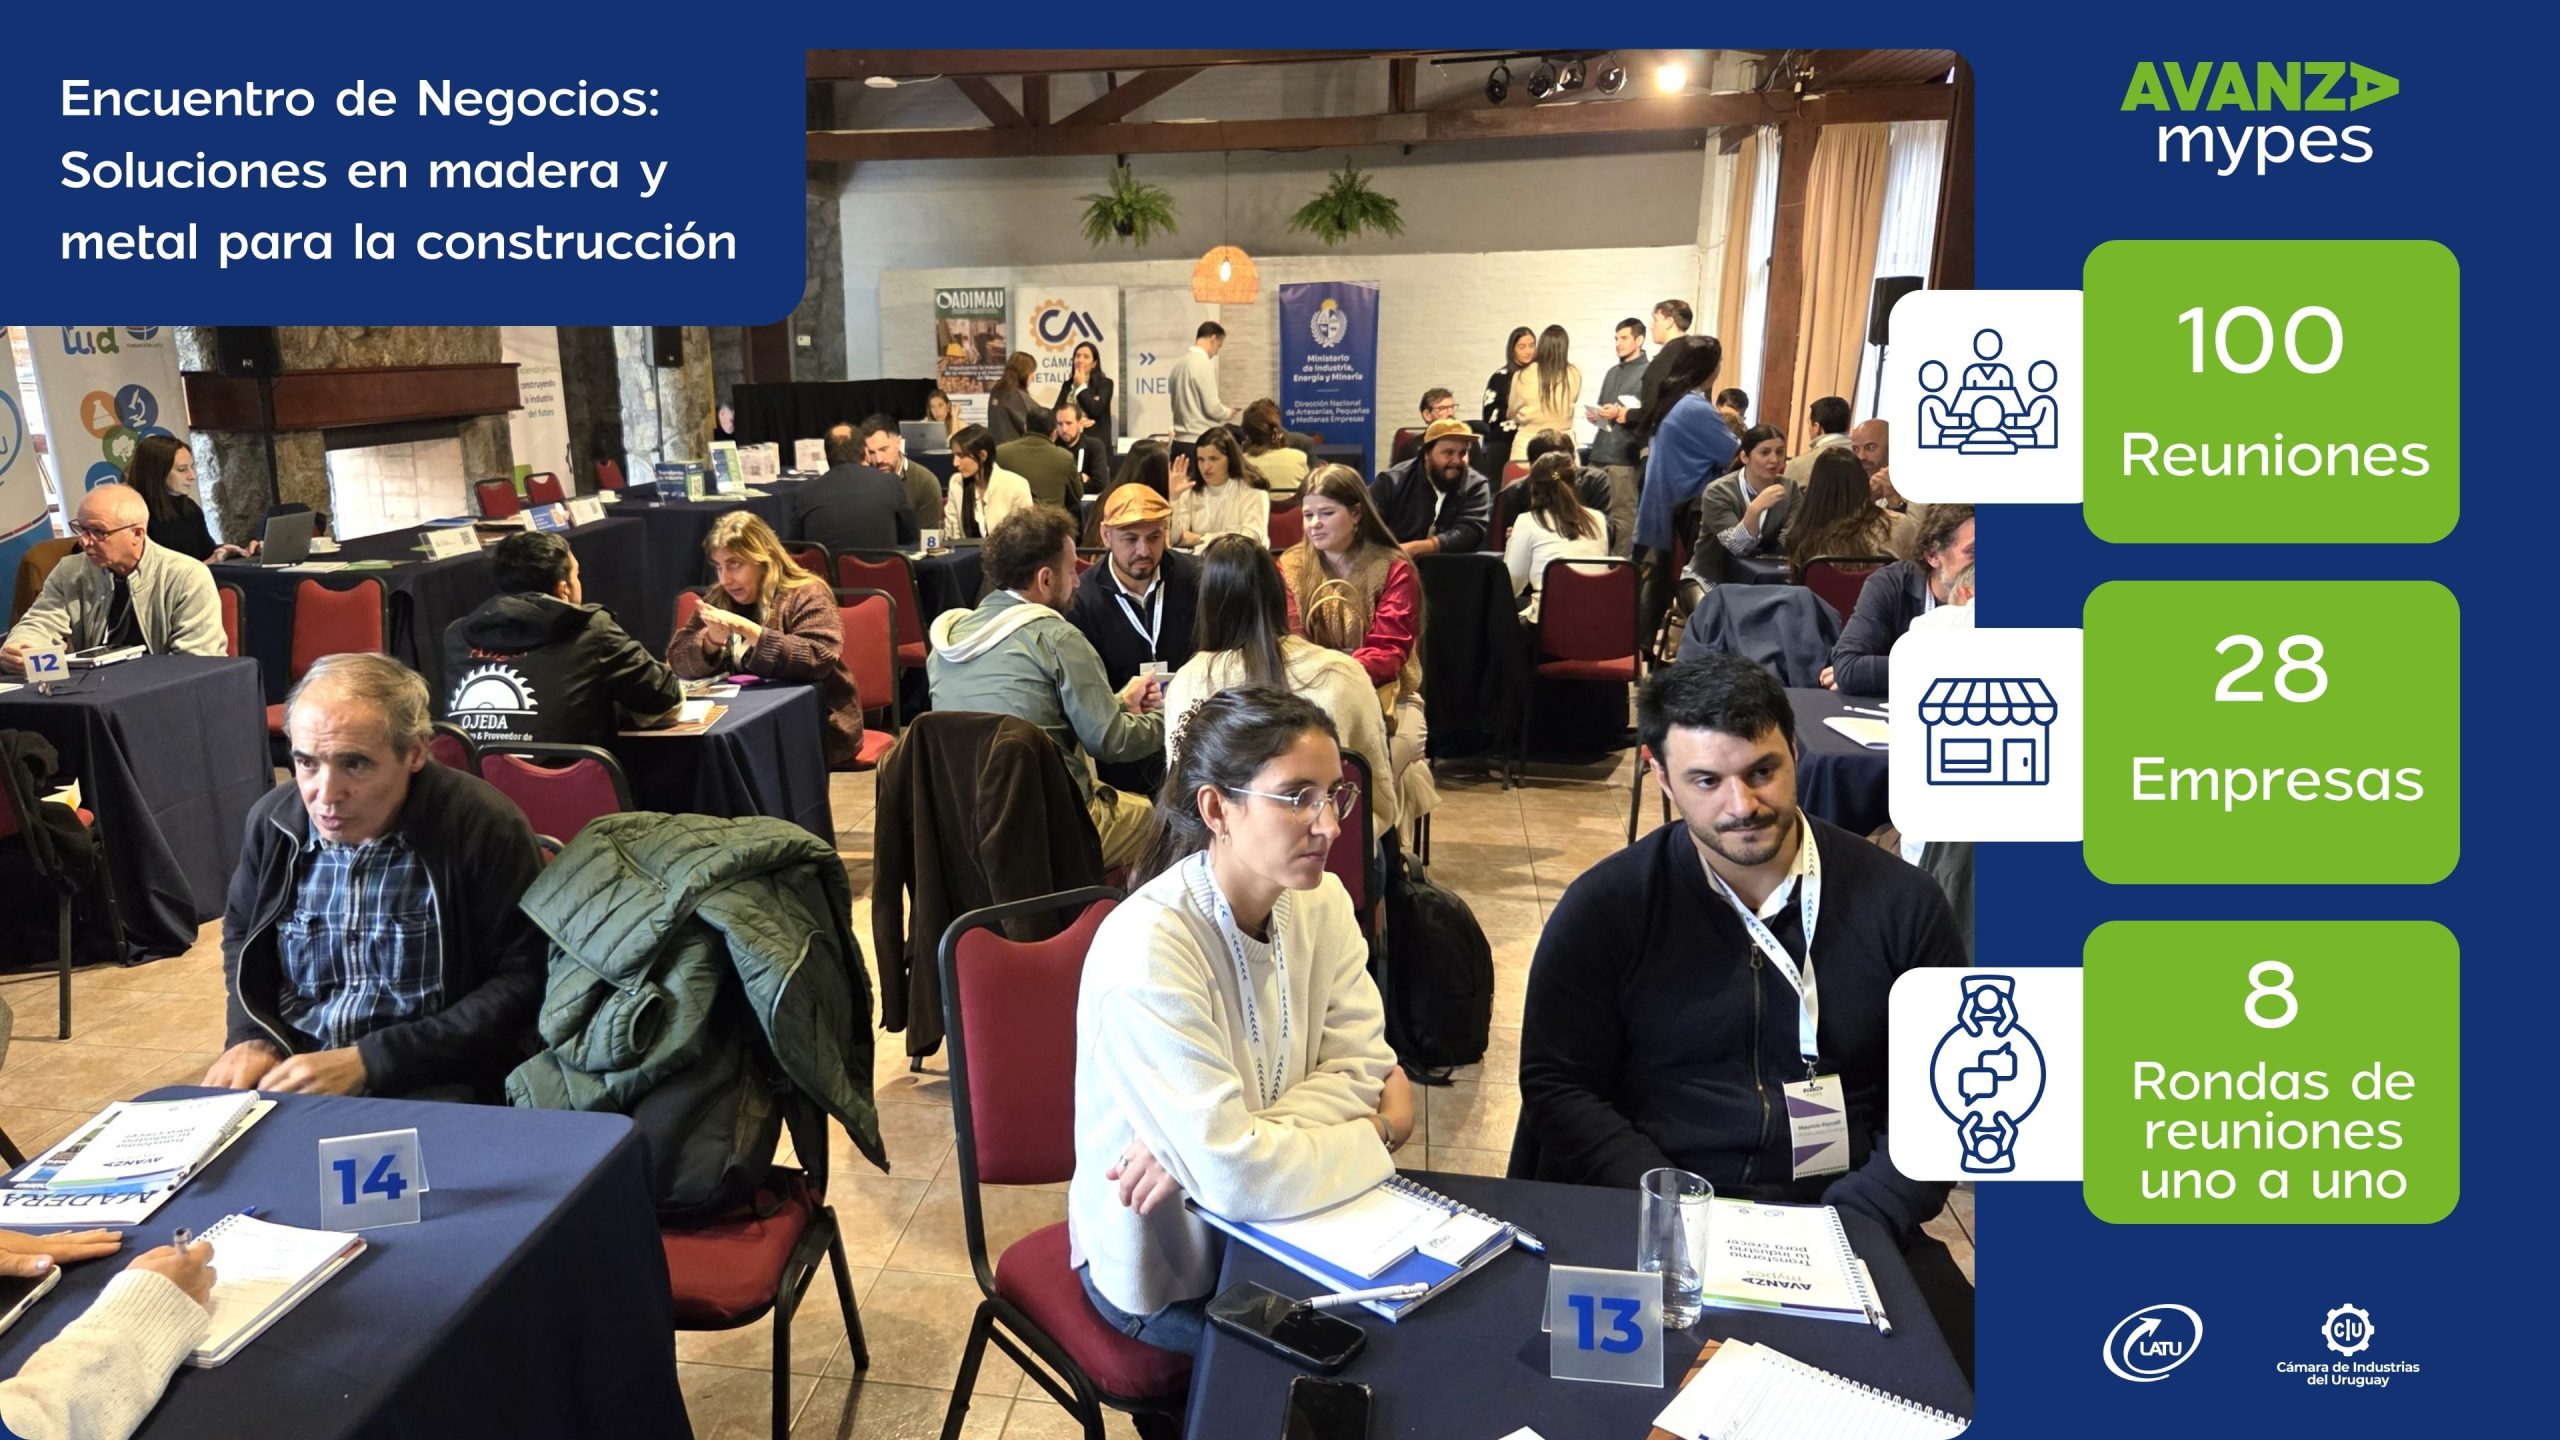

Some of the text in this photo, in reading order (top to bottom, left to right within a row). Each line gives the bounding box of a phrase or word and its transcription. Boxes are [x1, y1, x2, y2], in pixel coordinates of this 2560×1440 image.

[1042, 356, 1073, 369] CÁMA
[1307, 354, 1350, 363] Ministerio
[1302, 364, 1313, 372] de
[1293, 372, 1363, 383] Energía y Minería
[1136, 377, 1170, 394] INE
[926, 535, 937, 548] 8
[29, 653, 60, 673] 12
[461, 714, 509, 730] OJEDA
[483, 731, 522, 741] Proveedor
[522, 732, 533, 741] de
[333, 1154, 408, 1205] 14
[3, 1190, 161, 1207] MADERA
[1728, 1252, 1813, 1267] Transforma
[1741, 1277, 1812, 1291] AVANZA
[1568, 1294, 1644, 1354] 13
